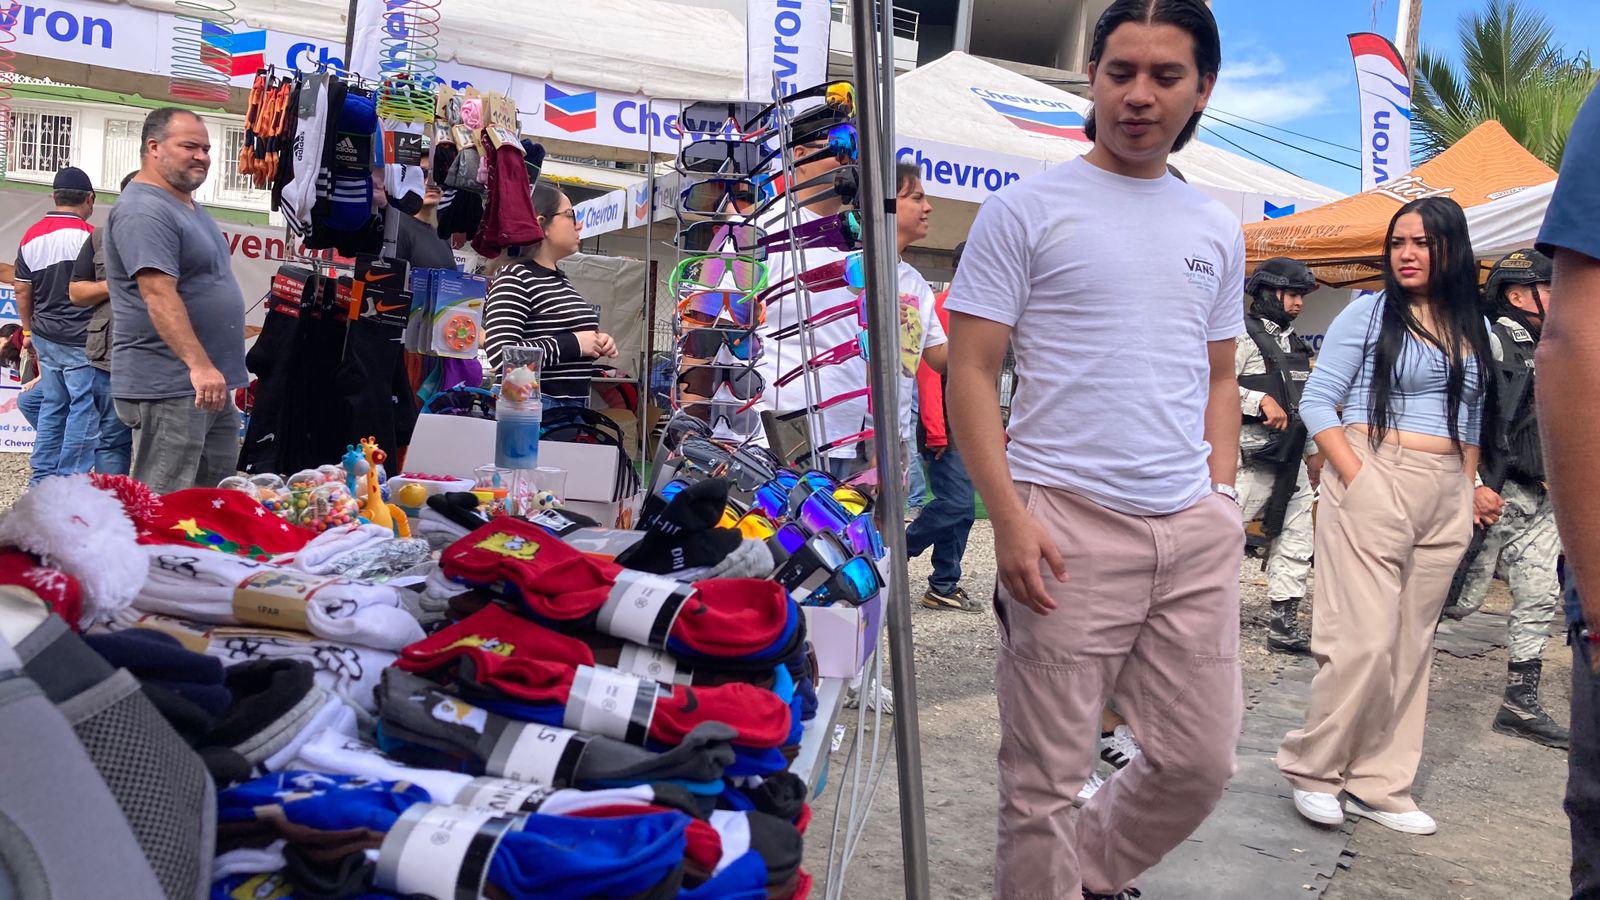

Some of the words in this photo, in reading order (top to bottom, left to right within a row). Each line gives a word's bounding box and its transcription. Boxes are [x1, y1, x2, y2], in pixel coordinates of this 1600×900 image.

[970, 87, 1072, 110] Chevron
[613, 101, 746, 148] Chevro
[336, 154, 358, 162] OCCER
[586, 203, 618, 228] Chevron
[1184, 258, 1215, 276] VANS
